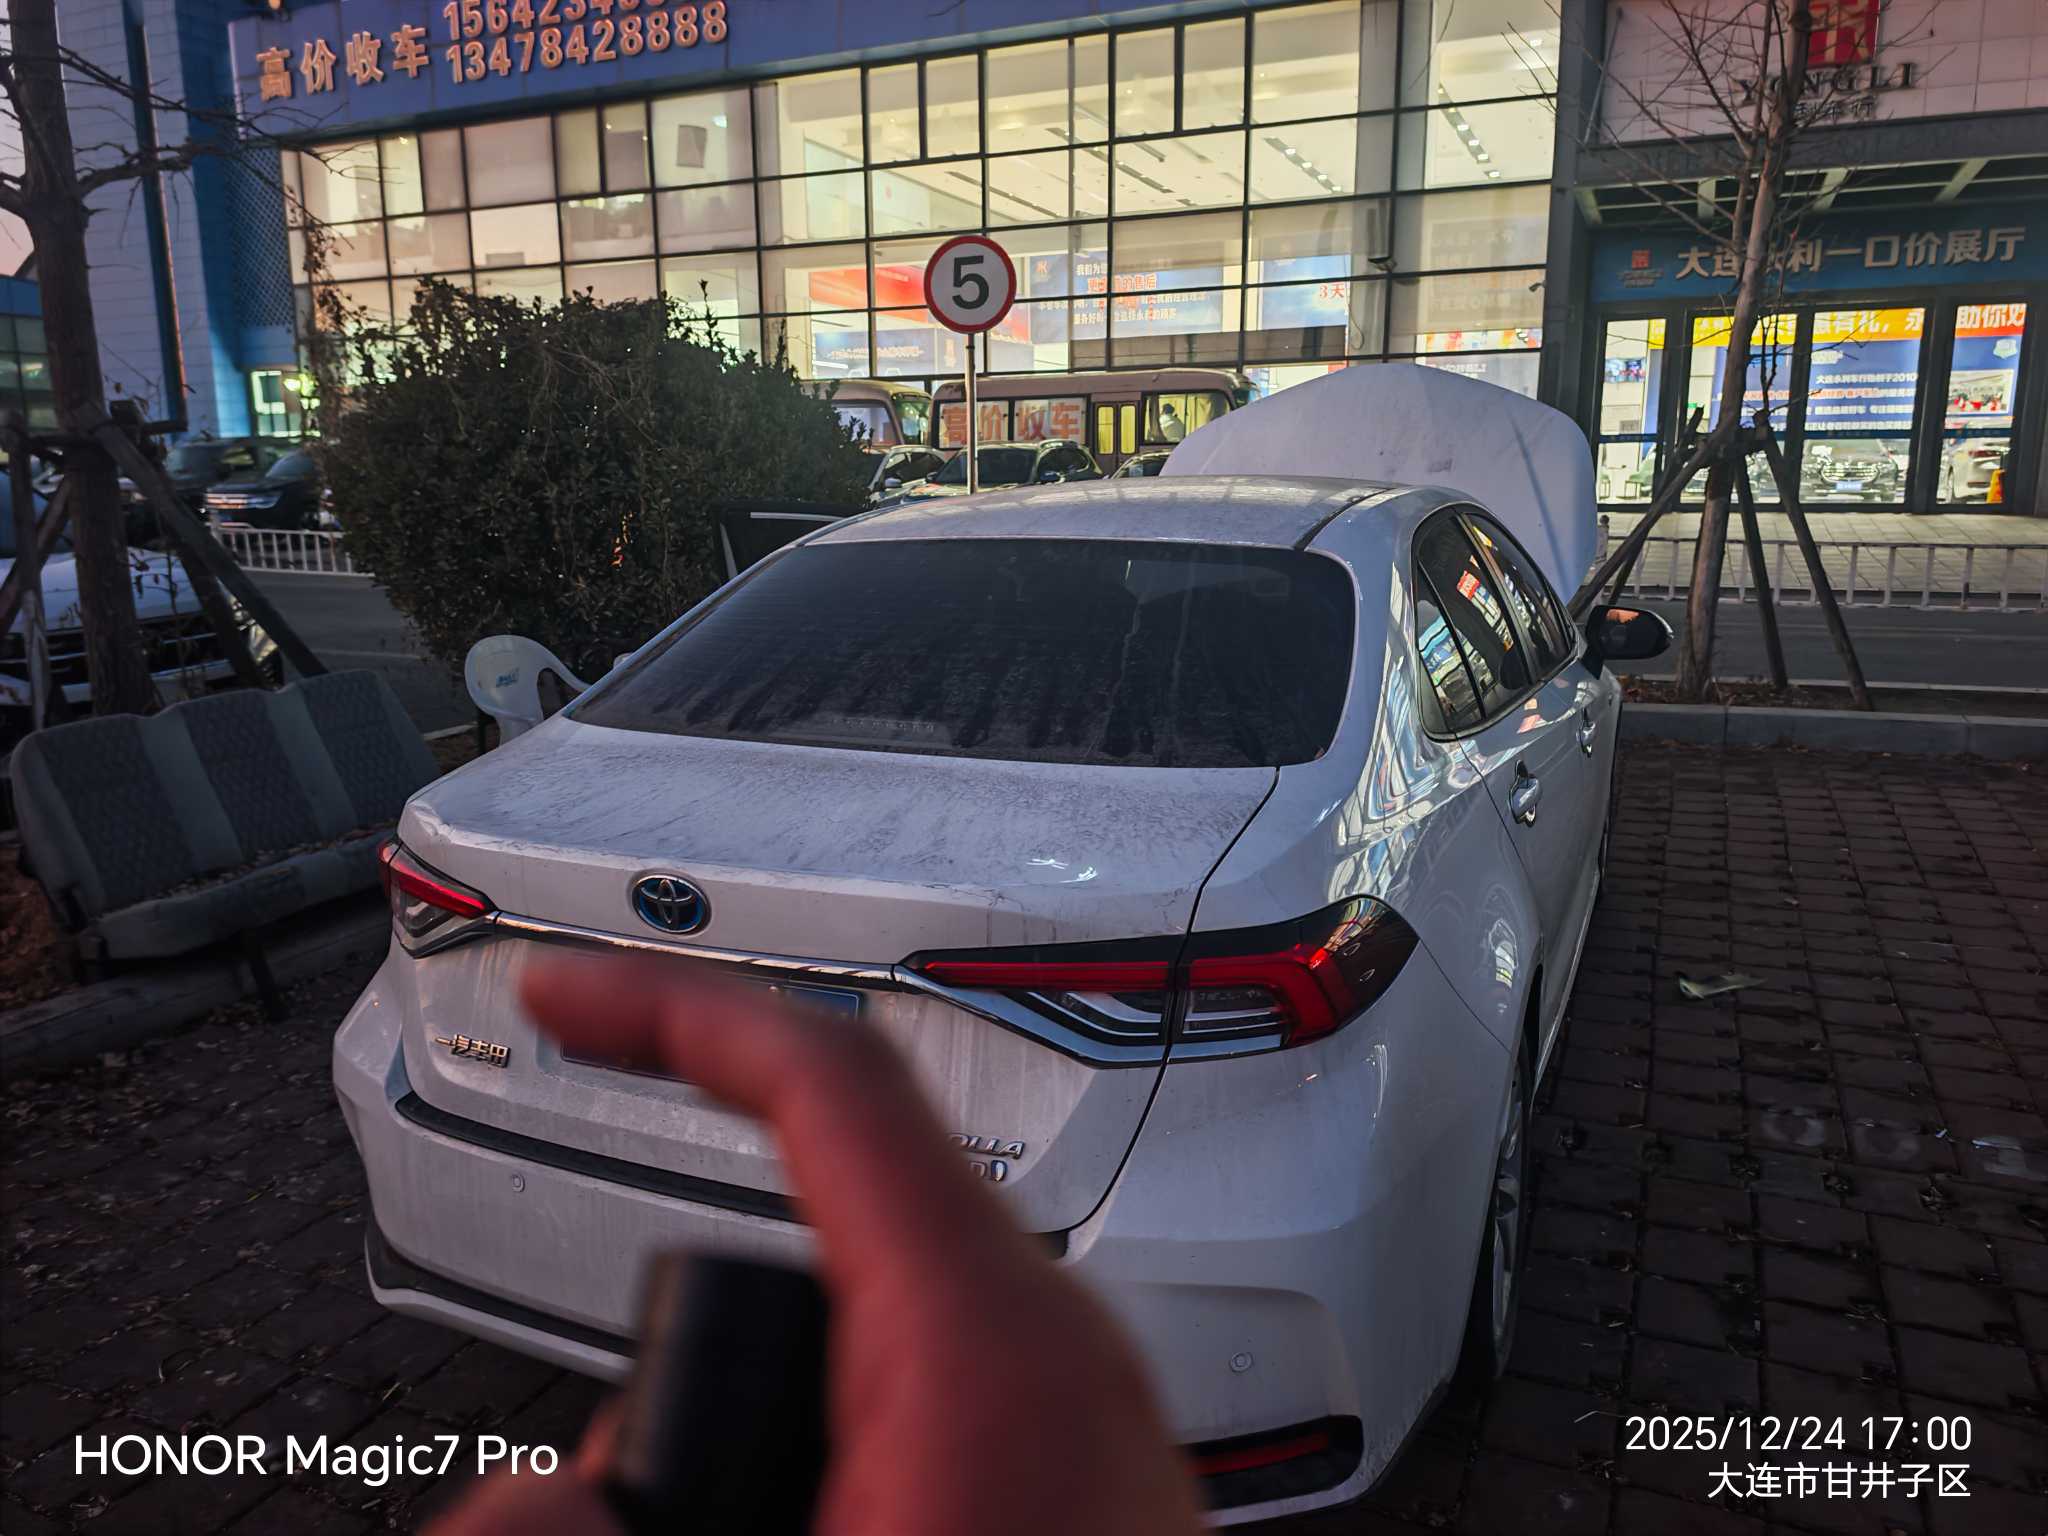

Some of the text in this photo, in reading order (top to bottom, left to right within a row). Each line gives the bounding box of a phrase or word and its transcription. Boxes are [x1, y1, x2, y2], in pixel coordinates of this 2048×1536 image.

[256, 23, 430, 102] 高价收车
[446, 0, 728, 83] 13478428888
[952, 255, 990, 310] 5
[942, 402, 1082, 446] 高价收车
[432, 1034, 511, 1067] 一汽丰田
